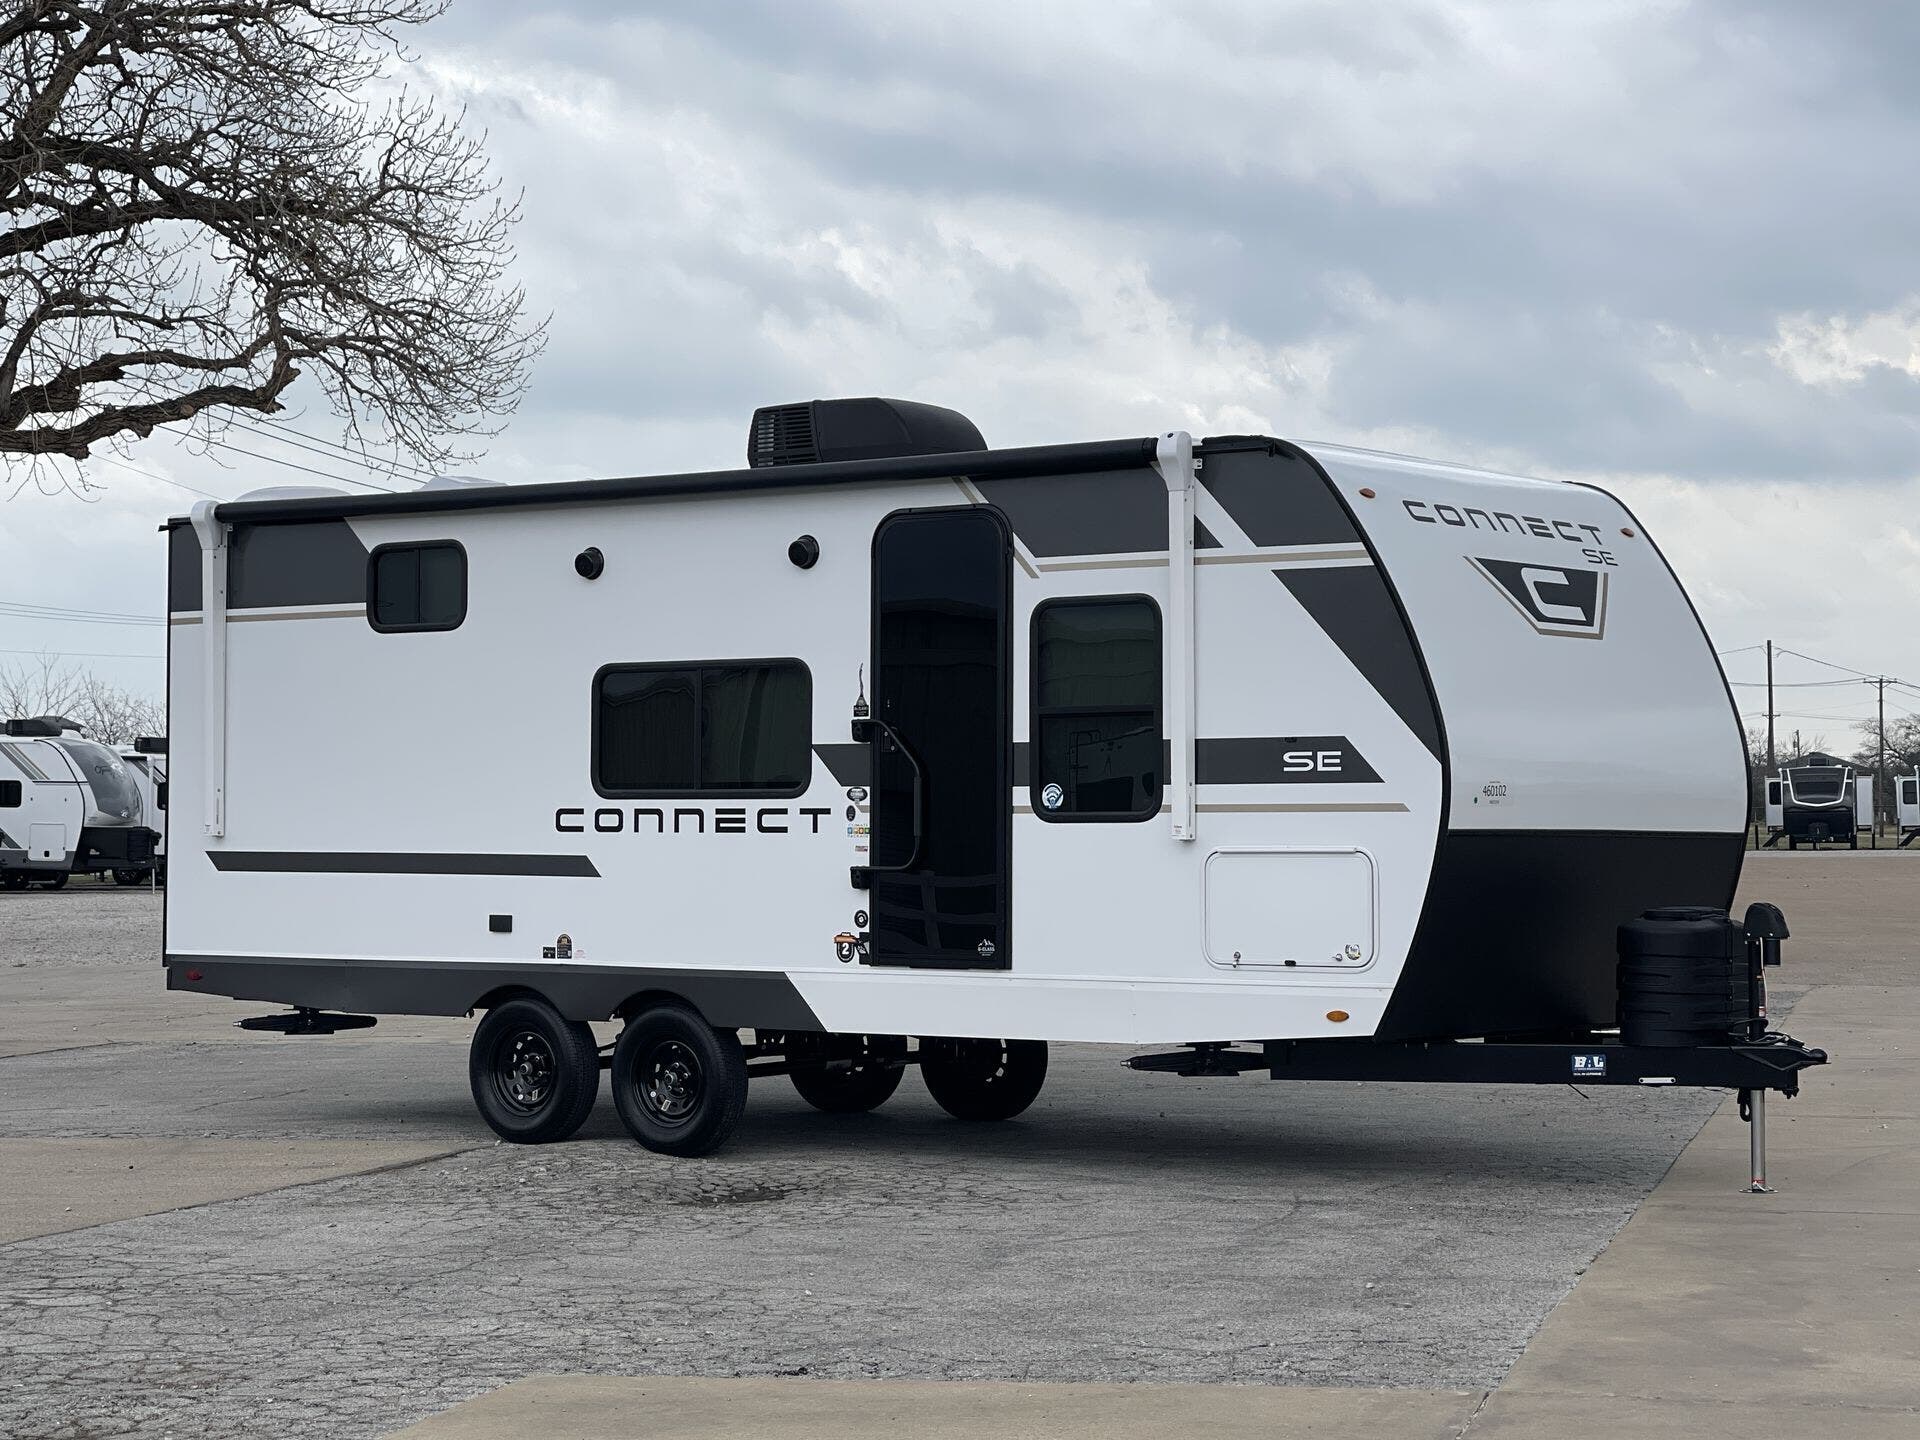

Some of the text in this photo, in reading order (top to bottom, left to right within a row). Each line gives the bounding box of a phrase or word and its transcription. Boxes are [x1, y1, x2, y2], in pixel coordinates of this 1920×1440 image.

[1402, 499, 1602, 546] CONNECT
[1581, 548, 1619, 567] SE
[1283, 750, 1342, 772] SE
[1482, 784, 1507, 797] 460102
[555, 807, 832, 834] CONNECT
[841, 942, 850, 955] 2
